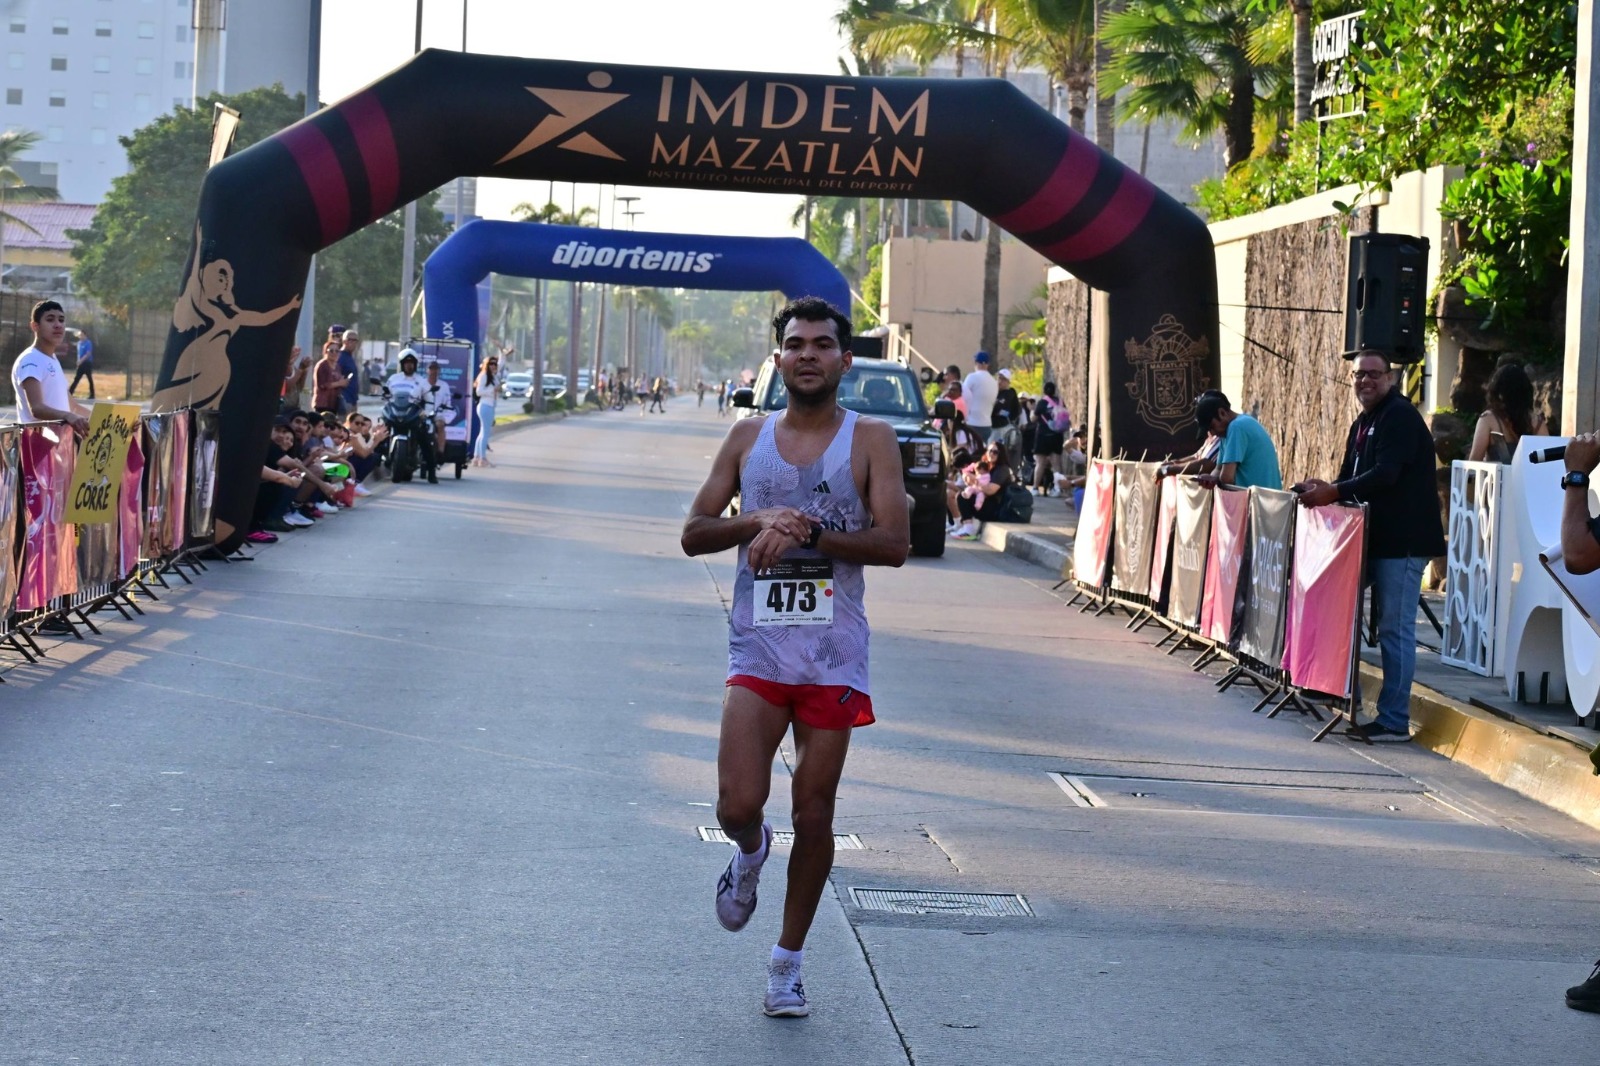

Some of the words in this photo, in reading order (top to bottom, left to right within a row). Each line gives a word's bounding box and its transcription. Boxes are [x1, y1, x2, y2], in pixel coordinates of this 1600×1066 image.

[656, 75, 930, 137] IMDEM
[650, 132, 924, 178] MAZATLÁN
[647, 170, 728, 182] INSTITUTO
[732, 175, 811, 187] MUNICIPAL
[818, 179, 844, 189] DEL
[849, 181, 914, 191] DEPORTE
[552, 241, 714, 273] dportenis
[75, 482, 112, 511] CORRE
[766, 581, 817, 613] 473
